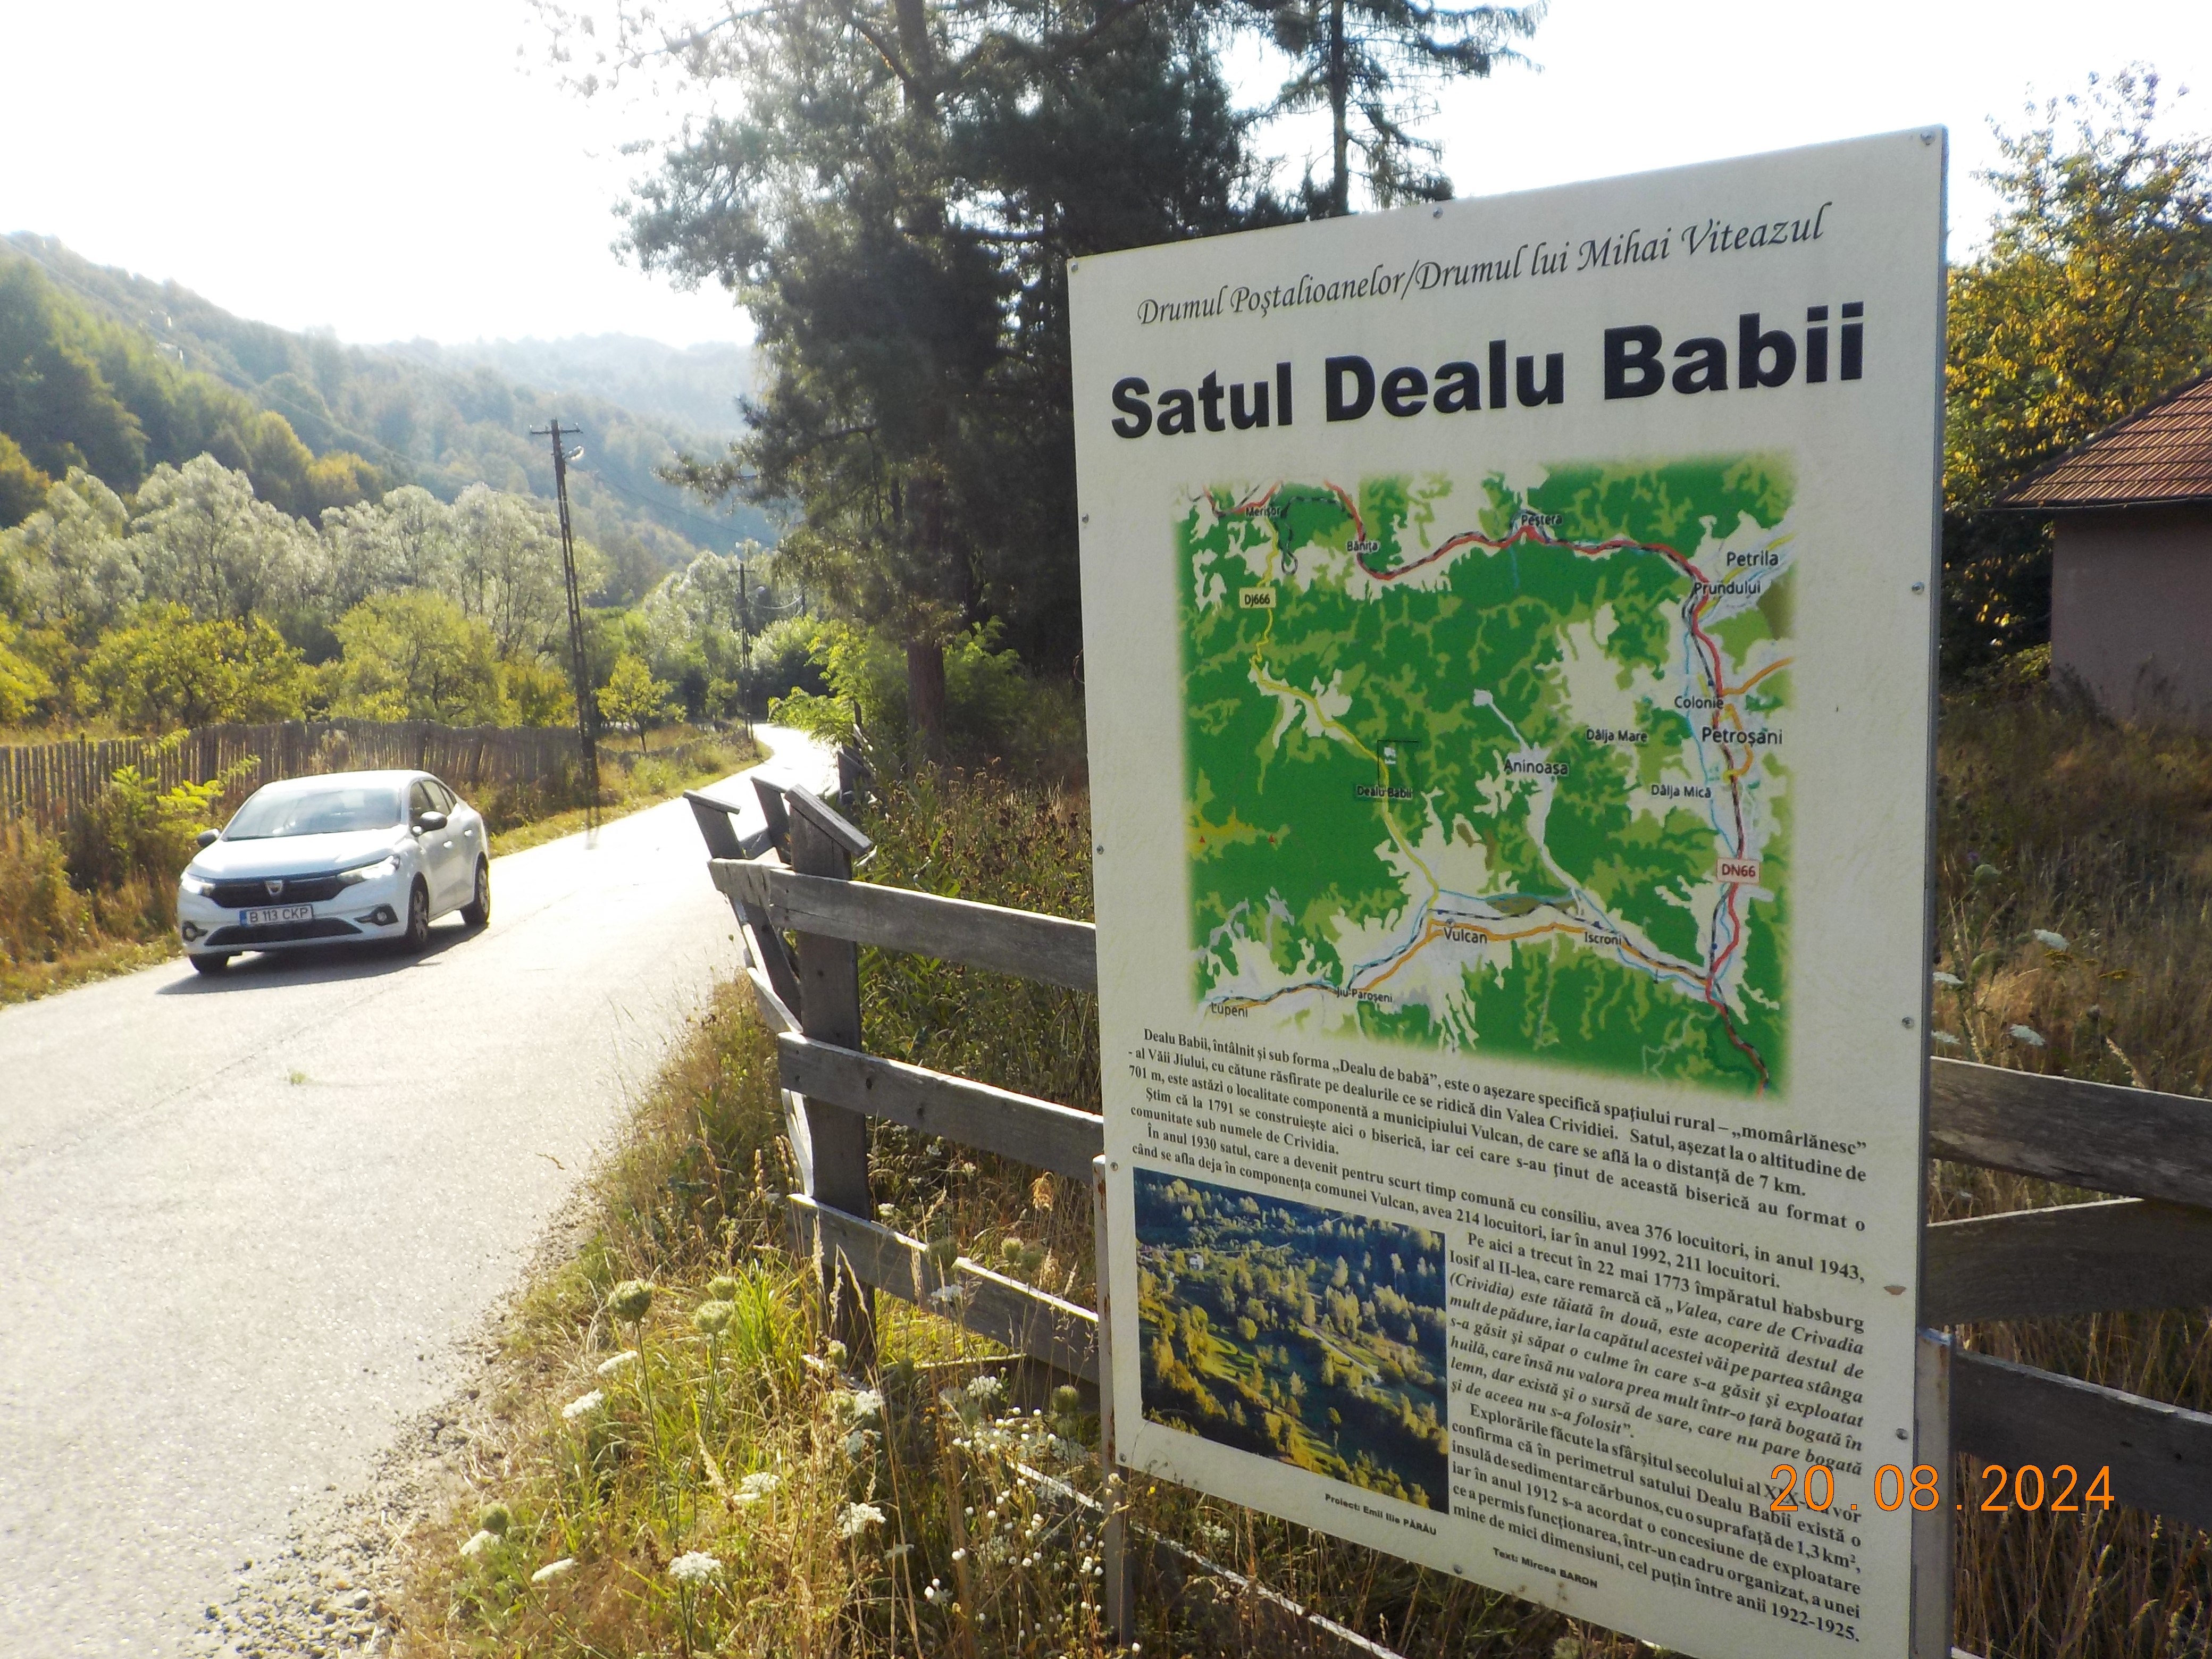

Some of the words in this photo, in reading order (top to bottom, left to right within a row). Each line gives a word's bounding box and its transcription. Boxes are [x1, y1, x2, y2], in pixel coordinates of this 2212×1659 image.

[1137, 285, 1228, 325] Drumul
[1530, 240, 1571, 276] lui
[1577, 227, 1673, 271] Mihai
[1681, 201, 1833, 256] Viteazul
[1111, 362, 1293, 439] Satul
[1325, 339, 1564, 422] Dealu
[1603, 301, 1864, 400] Babii
[1727, 550, 1779, 567] Petrila
[1245, 593, 1270, 607] DJ666
[1694, 580, 1762, 594] Prundului
[1674, 695, 1724, 710] Colonie
[1618, 730, 1647, 742] Mare
[1504, 759, 1568, 775] Aninoasa
[1357, 785, 1385, 797] Dealu
[1722, 863, 1756, 878] DN66
[249, 911, 258, 923] B
[263, 910, 278, 921] 113
[282, 907, 308, 920] CKP
[1444, 927, 1488, 944] Vulcan
[1585, 931, 1622, 945] Iscroni
[1143, 1027, 1176, 1045] Dealu
[1177, 1033, 1212, 1053] Babii,
[1212, 1038, 1255, 1058] întâlnit
[1268, 1049, 1291, 1064] sub
[1292, 1051, 1330, 1070] forma
[1378, 1065, 1395, 1080] de
[1443, 1079, 1470, 1093] este
[1472, 1083, 1481, 1094] o
[1537, 1093, 1601, 1115] specifică
[1673, 1115, 1715, 1133] rural
[1128, 1064, 1147, 1080] 701
[1150, 1071, 1166, 1085] m,
[1167, 1074, 1189, 1087] este
[1191, 1078, 1224, 1093] astăzi
[1226, 1084, 1234, 1095] o
[1235, 1082, 1291, 1105] localitate
[1292, 1096, 1369, 1119] componentă
[1371, 1110, 1380, 1121] a
[1382, 1111, 1468, 1136] municipiului
[1470, 1123, 1523, 1149] Vulcan,
[1527, 1133, 1545, 1150] de
[1547, 1141, 1579, 1156] care
[1582, 1146, 1598, 1159] se
[1601, 1147, 1630, 1166] află
[1634, 1151, 1649, 1169] la
[1652, 1159, 1662, 1171] o
[1735, 1170, 1755, 1188] de
[1758, 1174, 1770, 1189] 7
[1773, 1176, 1806, 1197] km.
[1130, 1106, 1193, 1127] comunitate
[1195, 1117, 1217, 1132] sub
[1219, 1122, 1263, 1141] numele
[1265, 1129, 1281, 1144] de
[1283, 1132, 1339, 1155] Crividia.
[1146, 1121, 1160, 1140] În
[1162, 1132, 1188, 1146] anul
[1191, 1134, 1217, 1152] 1930
[1219, 1143, 1252, 1160] satul,
[1254, 1150, 1280, 1164] care
[1283, 1155, 1291, 1166] a
[1293, 1155, 1339, 1176] devenit
[1341, 1167, 1385, 1185] pentru
[1387, 1176, 1422, 1193] scurt
[1425, 1181, 1457, 1203] timp
[1460, 1191, 1516, 1211] comună
[1519, 1202, 1537, 1216] cu
[1540, 1206, 1602, 1231] consiliu,
[1605, 1219, 1641, 1237] avea
[1644, 1224, 1673, 1243] 376
[1677, 1229, 1750, 1261] locuitori,
[1775, 1253, 1814, 1271] anul
[1820, 1259, 1865, 1285] 1943,
[1467, 1231, 1485, 1249] Pe
[1488, 1238, 1513, 1255] aici
[1517, 1246, 1526, 1258] a
[1530, 1246, 1573, 1268] trecut
[1577, 1254, 1593, 1272] în
[1597, 1259, 1615, 1277] 22
[1620, 1268, 1648, 1284] mai
[1654, 1272, 1690, 1293] 1773
[1694, 1279, 1777, 1313] împăratul
[1782, 1298, 1865, 1335] habsburg
[1448, 1271, 1515, 1301] (Crividia)
[1520, 1291, 1548, 1306] este
[1552, 1296, 1594, 1317] tăiată
[1599, 1305, 1614, 1321] în
[1620, 1311, 1663, 1335] două,
[1668, 1326, 1699, 1341] este
[1704, 1333, 1780, 1360] acoperită
[1786, 1349, 1838, 1373] destul
[1842, 1362, 1865, 1379] de
[1464, 1381, 1481, 1397] de
[1484, 1389, 1524, 1409] aceea
[1527, 1401, 1547, 1415] nu
[1549, 1407, 1572, 1422] s-a
[1451, 1422, 1514, 1448] confirma
[1517, 1439, 1534, 1455] că
[1536, 1442, 1552, 1460] în
[1555, 1451, 1635, 1484] perimetrul
[1639, 1474, 1691, 1501] satului
[1696, 1487, 1742, 1514] Dealu
[1748, 1502, 1792, 1529] Babii
[1796, 1520, 1846, 1544] există
[1850, 1536, 1862, 1548] o
[1452, 1460, 1472, 1478] iar
[1473, 1466, 1488, 1484] în
[1491, 1476, 1522, 1494] anul
[1526, 1482, 1559, 1504] 1912
[1561, 1496, 1583, 1512] s-a
[1586, 1504, 1644, 1530] acordat
[1646, 1522, 1656, 1534] o
[1660, 1526, 1745, 1561] concesiune
[1748, 1549, 1769, 1568] de
[1772, 1560, 1862, 1596] exploatare
[1453, 1505, 1486, 1524] mine
[1488, 1513, 1505, 1530] de
[1507, 1522, 1538, 1541] mici
[1540, 1530, 1624, 1570] dimensiuni,
[1627, 1560, 1648, 1576] cel
[1694, 1577, 1733, 1603] între
[1736, 1594, 1767, 1614] anii
[1771, 1602, 1860, 1643] 1922-1925.
[1493, 1547, 1518, 1562] Text:
[1522, 1556, 1556, 1575] Mircea
[1560, 1569, 1598, 1589] BARON
